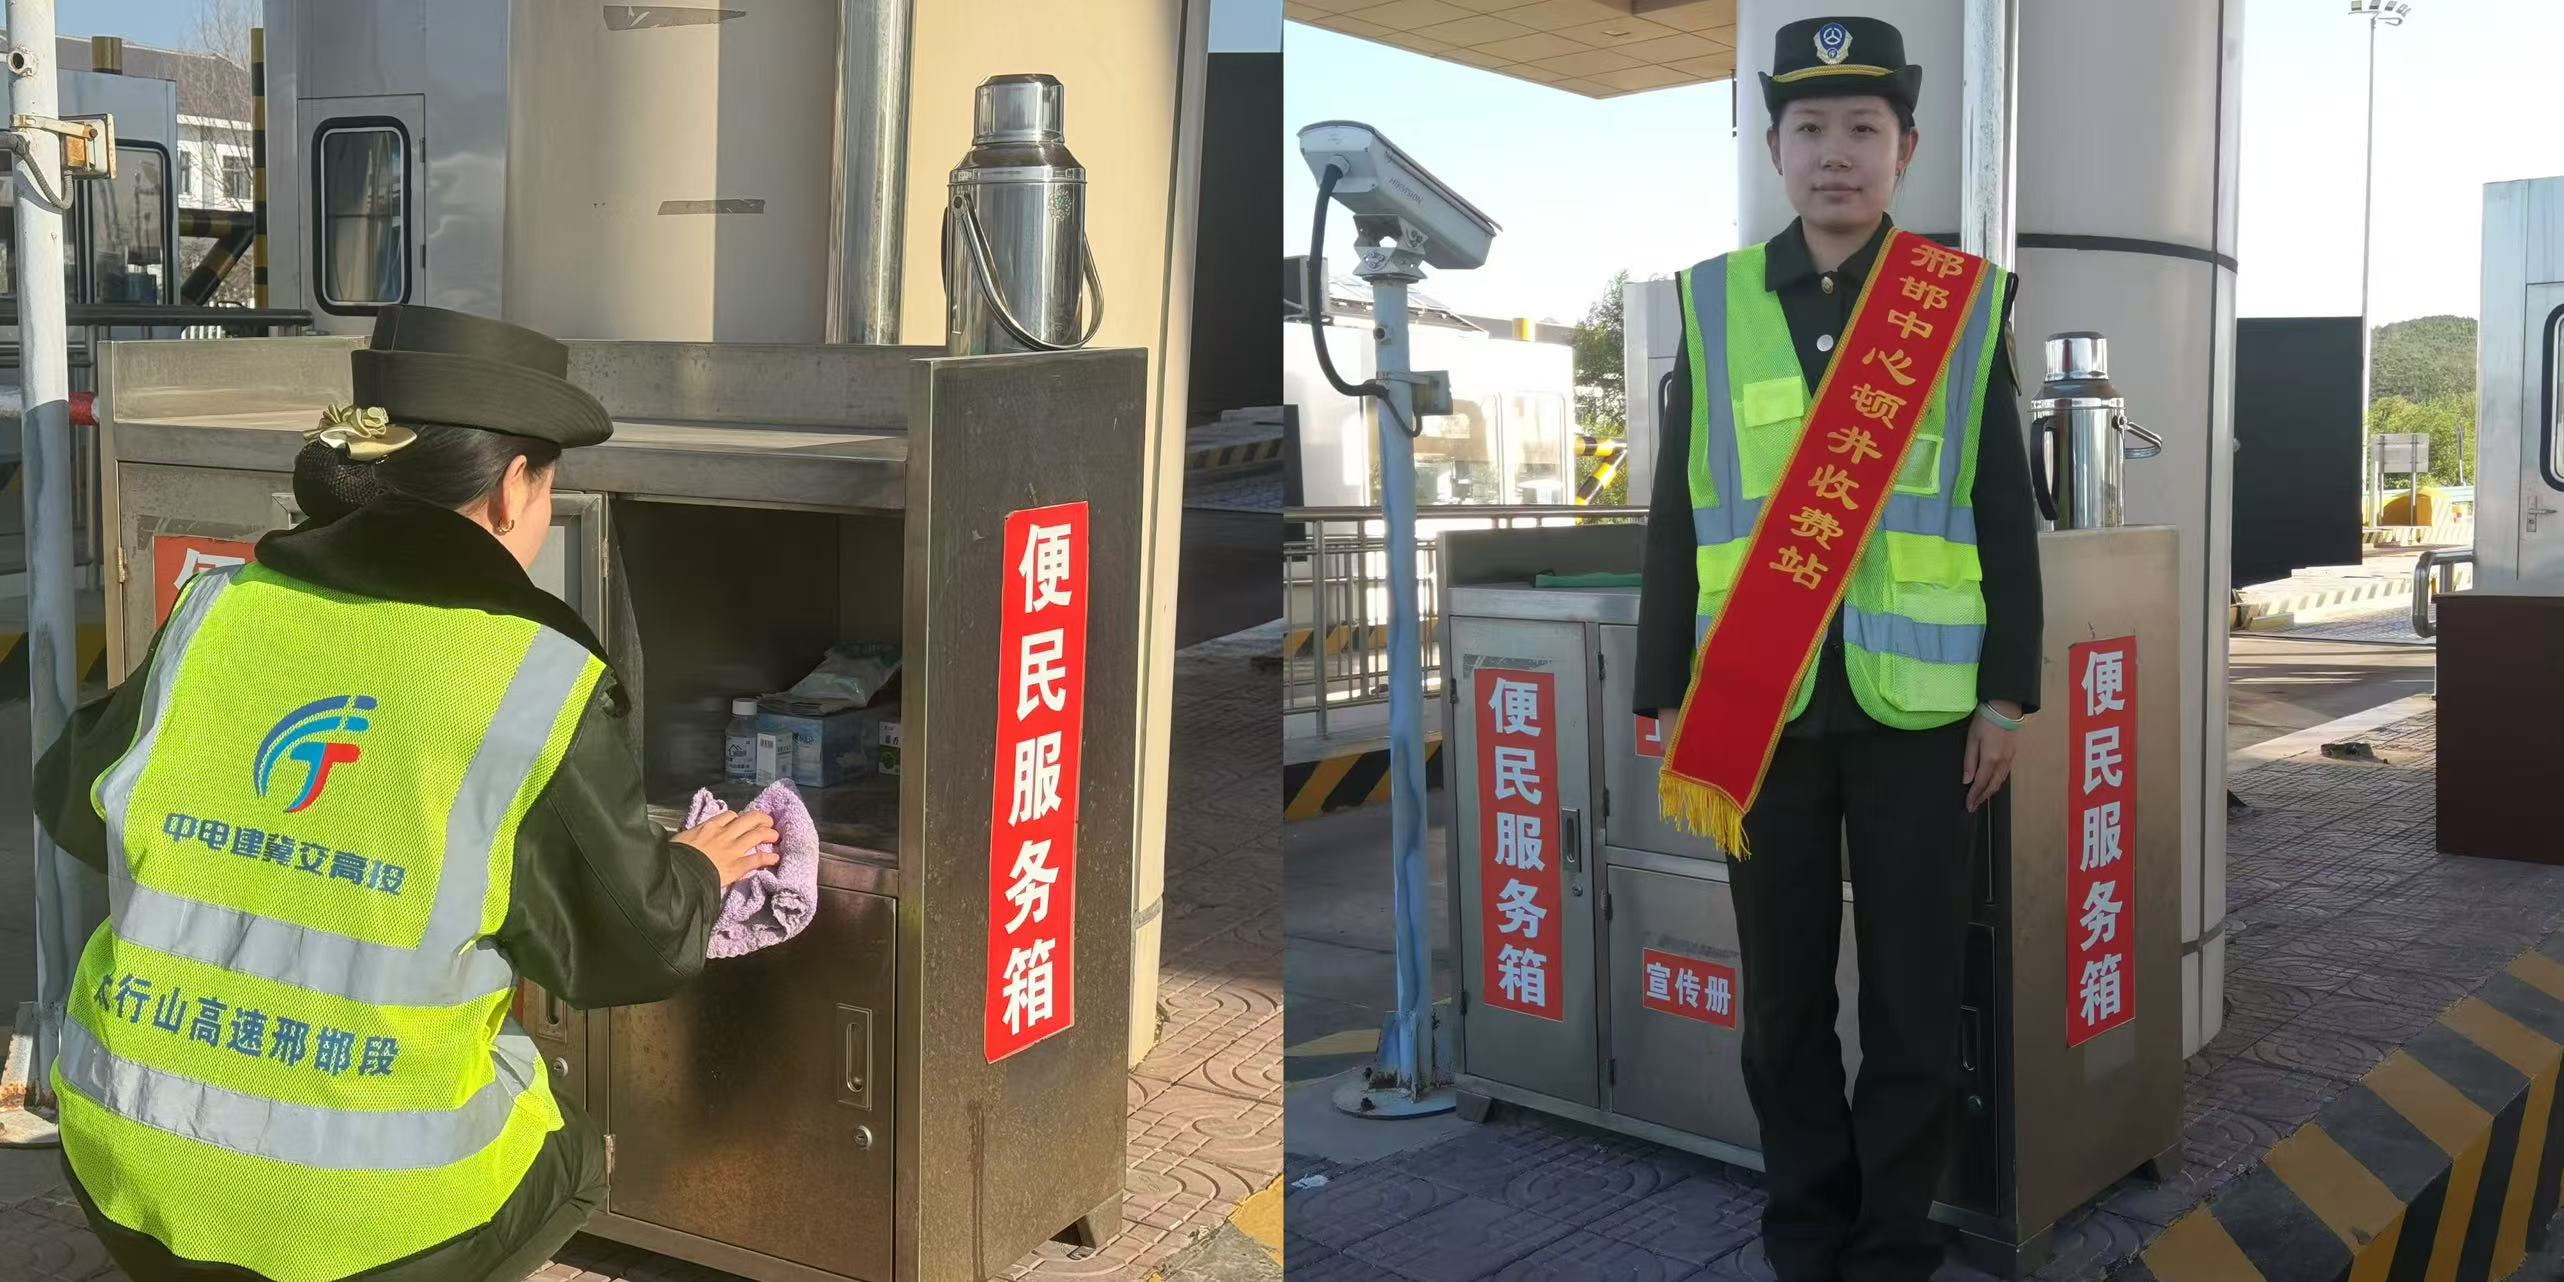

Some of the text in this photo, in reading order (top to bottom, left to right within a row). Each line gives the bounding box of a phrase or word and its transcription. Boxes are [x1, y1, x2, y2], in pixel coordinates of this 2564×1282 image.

[1769, 244, 1965, 590] 邢邯中心顿井收费站
[1002, 523, 1072, 1036] 便民服务箱
[1488, 677, 1547, 1007] 便民服务箱
[2080, 650, 2125, 1026] 便民服务箱
[1646, 962, 1732, 1015] 宣传册
